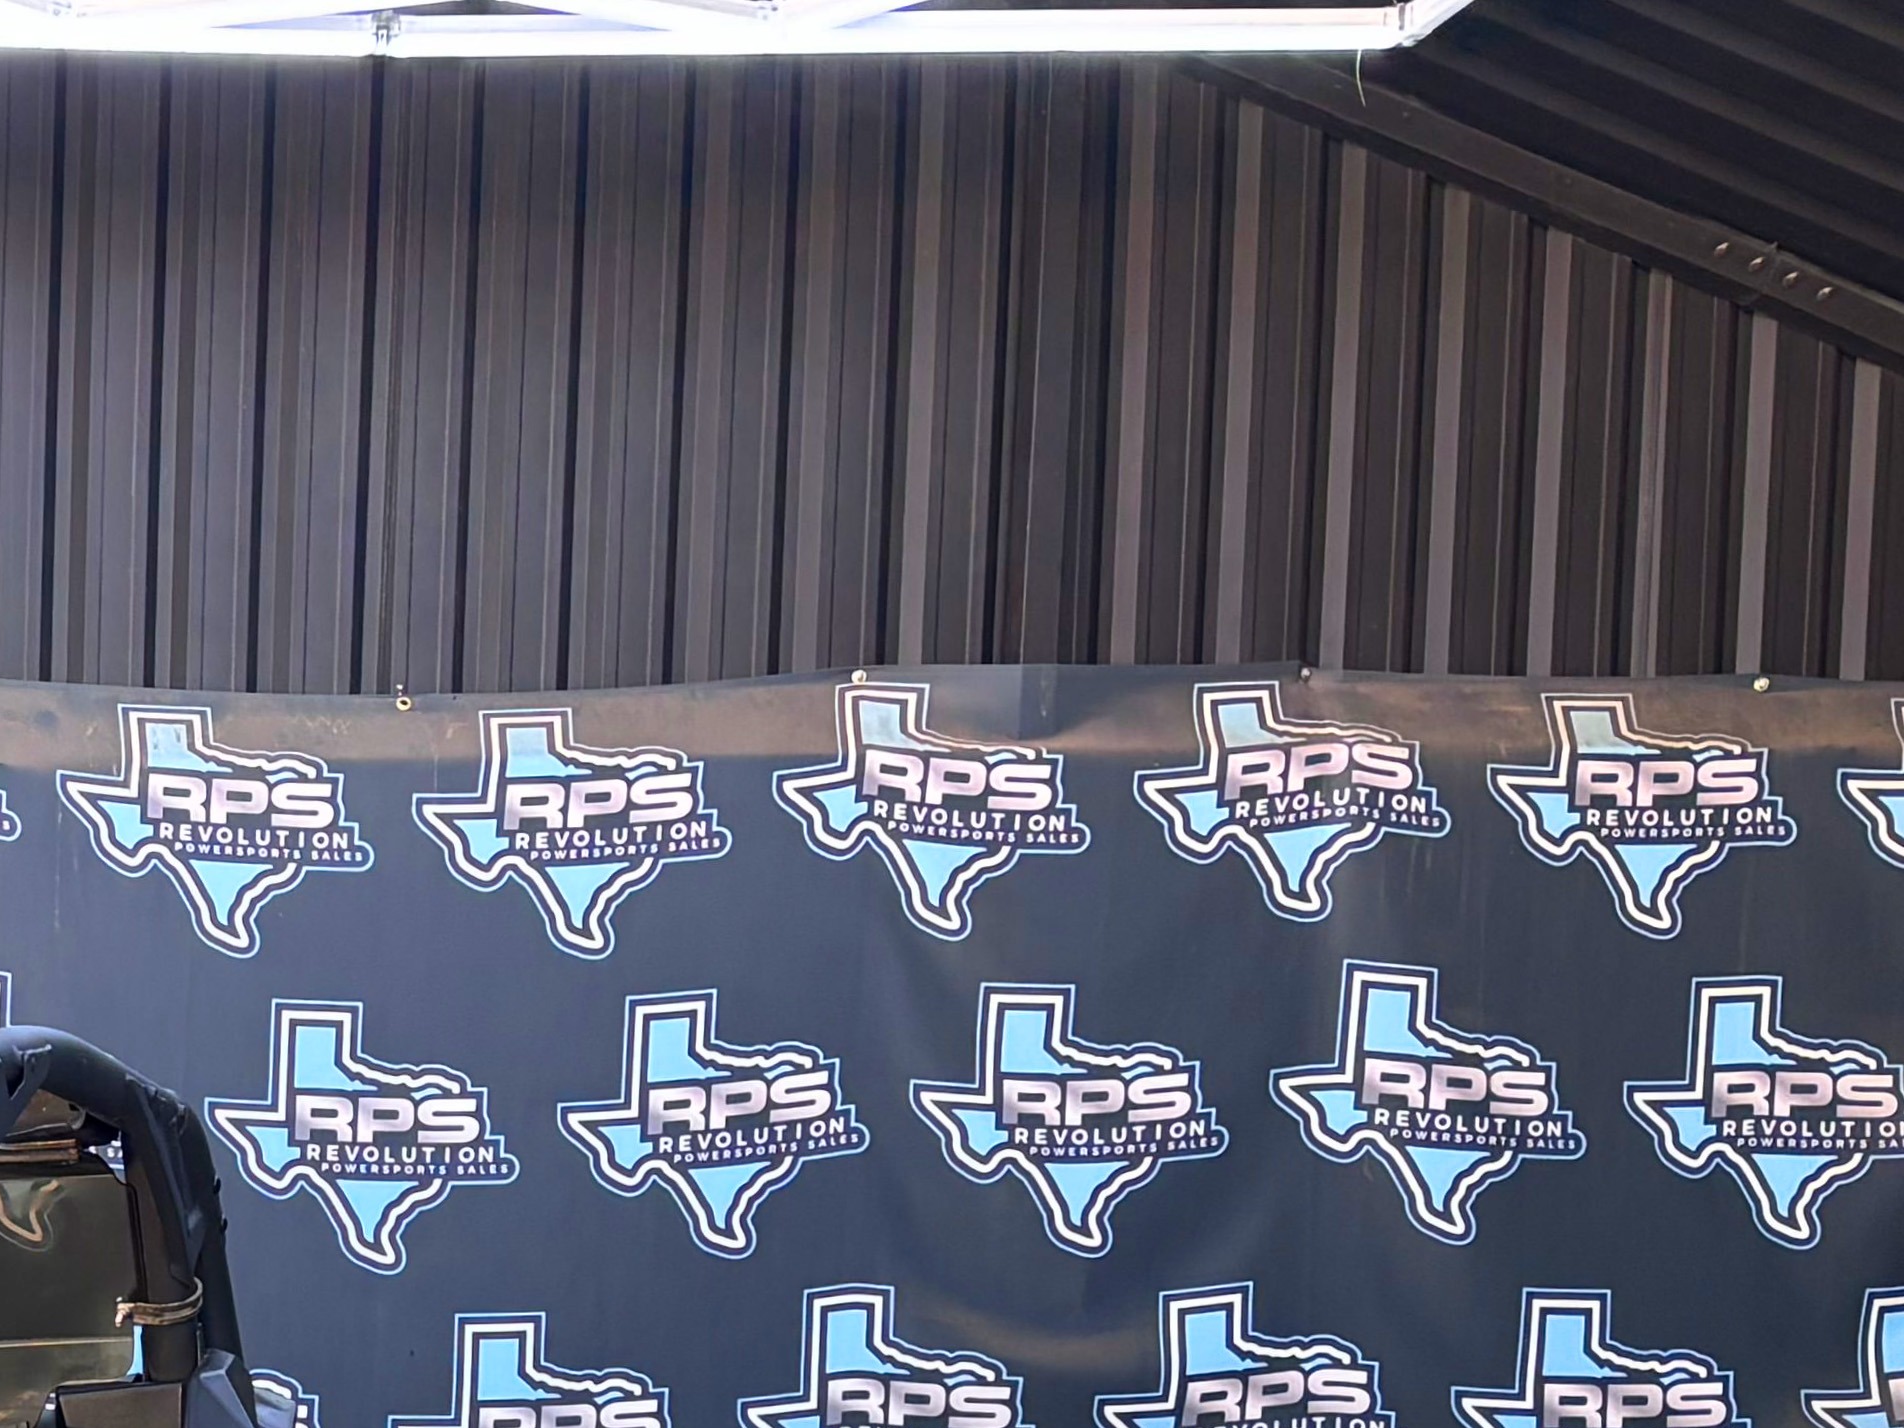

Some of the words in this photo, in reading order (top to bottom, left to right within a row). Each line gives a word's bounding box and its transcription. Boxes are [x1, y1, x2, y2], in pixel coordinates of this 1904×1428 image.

[863, 749, 1052, 810] RPS
[1223, 741, 1413, 800] RPS
[1576, 759, 1758, 806] RPS
[148, 774, 334, 828] RPS
[504, 773, 693, 830] RPS
[874, 800, 1064, 831] REVOLUTION
[1235, 787, 1428, 819] REVOLUTION
[1587, 807, 1771, 826] REVOLUTION
[160, 822, 348, 849] REVOLUTION
[516, 821, 706, 849] REVOLUTION
[888, 821, 1015, 842] POWERSPORTS
[1027, 834, 1078, 843] SALES
[1601, 827, 1724, 838] POWERSPORTS
[1735, 825, 1785, 835] SALES
[175, 842, 300, 859] POWERSPORTS
[312, 850, 362, 861] SALES
[531, 844, 658, 860] POWERSPORTS
[669, 838, 720, 852] SALES
[648, 1071, 831, 1134] RPS
[1003, 1073, 1191, 1126] RPS
[1362, 1058, 1548, 1116] RPS
[296, 1095, 479, 1143] RPS
[1015, 1120, 1204, 1145] REVOLUTION
[1374, 1108, 1561, 1137] REVOLUTION
[660, 1117, 844, 1153] REVOLUTION
[1030, 1143, 1156, 1156] POWERSPORTS
[1168, 1137, 1221, 1150] SALES
[307, 1144, 493, 1163] REVOLUTION
[322, 1163, 446, 1174] POWERSPORTS
[458, 1164, 508, 1174] SALES
[1544, 1382, 1726, 1428] RPS
